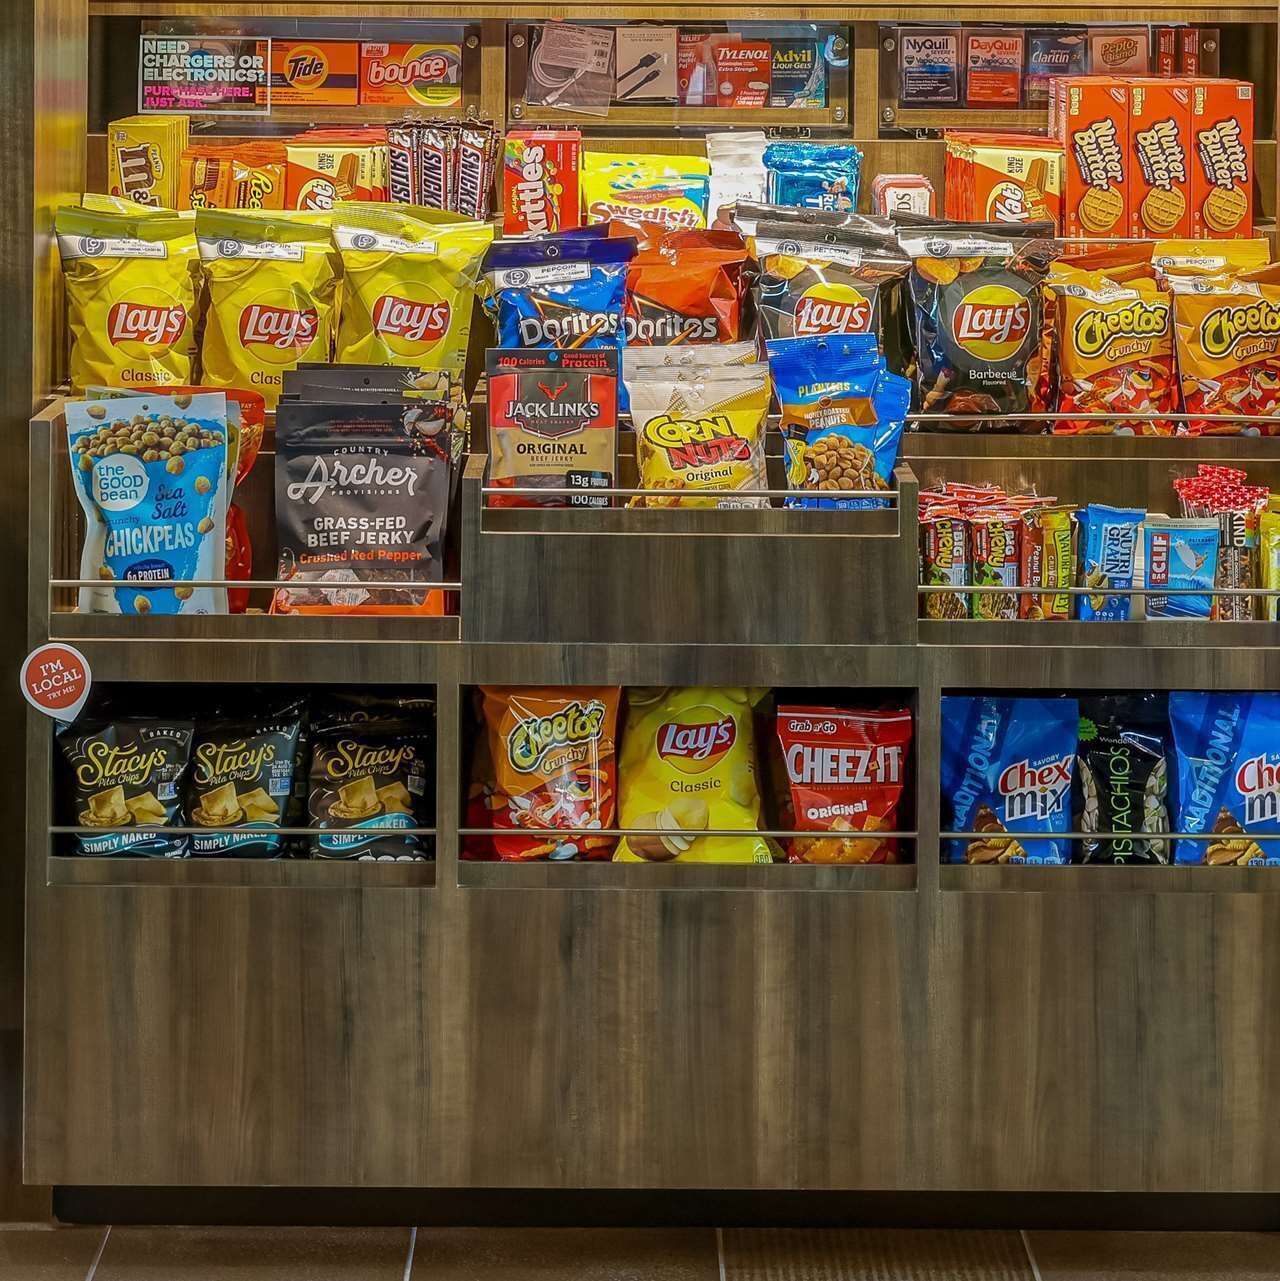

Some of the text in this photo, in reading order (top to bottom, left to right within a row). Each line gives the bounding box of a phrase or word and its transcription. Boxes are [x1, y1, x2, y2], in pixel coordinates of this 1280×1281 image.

[144, 41, 189, 53] NEED
[718, 48, 768, 59] TYLENOL
[906, 39, 949, 52] NyQuil
[971, 39, 1018, 53] DayQuil
[144, 55, 264, 68] CHARGERS OR
[773, 50, 811, 62] Advil
[1032, 50, 1069, 64] Claritin
[144, 68, 265, 82] ELECTRONICS?
[289, 56, 324, 82] Tide
[370, 58, 445, 84] bounce
[144, 86, 215, 96] PURCHASE
[144, 97, 208, 108] JUST ASK.
[1074, 129, 1110, 190] Butter
[1092, 118, 1124, 183] Nutter
[1136, 129, 1172, 190] Butter
[1154, 118, 1185, 183] Nutter
[1199, 129, 1234, 190] Butter
[1216, 118, 1248, 183] Nutter
[151, 148, 162, 173] PEANUT
[318, 153, 326, 169] KING
[327, 153, 335, 169] SIZE
[1007, 156, 1015, 174] KING
[1016, 155, 1024, 174] SIZE
[112, 303, 185, 347] Lay's
[375, 295, 450, 341] Lay's
[799, 299, 865, 333] Lay's
[959, 302, 1026, 344] Lay's
[243, 305, 319, 349] Lay's
[522, 312, 618, 346] Doritos
[625, 317, 717, 341] Doritos
[1074, 303, 1169, 358] Cheetos
[1107, 339, 1151, 361] Crunchy
[1234, 338, 1277, 359] Crunchy
[499, 357, 517, 367] 100
[562, 360, 608, 368] Protein
[121, 368, 171, 385] Classic
[969, 367, 1017, 380] Barbecue
[799, 382, 851, 397] PLANTERS
[505, 401, 599, 418] JACK LINK'S
[810, 414, 847, 428] PEANUTS
[644, 415, 733, 448] CORN
[334, 446, 389, 456] COUNTRY
[517, 443, 587, 454] ORIGINAL
[669, 437, 750, 470] NUTS
[97, 465, 124, 476] the
[686, 467, 732, 481] Original
[99, 476, 143, 490] GOOD
[287, 456, 417, 505] Archer
[571, 475, 589, 487] 13g
[100, 490, 138, 502] bean
[155, 484, 184, 500] Sea
[152, 504, 188, 520] Salt
[313, 516, 407, 531] GRASS-FED
[1233, 511, 1246, 547] KIND
[105, 522, 195, 557] CHICKPEAS
[307, 530, 414, 548] BEEF JERKY
[954, 532, 962, 556] BIG
[300, 549, 422, 565] Crushed Red Pepper
[1058, 533, 1070, 564] NATURE
[1106, 527, 1120, 575] GRAIN
[1120, 527, 1132, 574] NUTRI
[1152, 535, 1167, 573] CLIF
[1033, 545, 1042, 571] Peanut
[138, 568, 170, 580] PROTEIN
[39, 660, 64, 677] I'M
[32, 668, 82, 695] LOCAL
[47, 685, 76, 700] TRY ME!
[149, 730, 181, 738] BAKED
[788, 720, 837, 734] Grab Go
[509, 700, 607, 773] Cheetos
[661, 720, 732, 760] Lay's
[77, 741, 167, 786] Stacy's
[194, 741, 275, 784] Stacy's
[327, 740, 415, 778] Stacy's
[543, 747, 588, 772] Crunchy
[1033, 754, 1060, 767] SAVORY
[98, 773, 139, 787] Pita Chips
[209, 770, 250, 786] Pita Chips
[999, 755, 1075, 796] Chex
[670, 779, 721, 793] Classic
[1006, 785, 1070, 822] mix
[84, 837, 119, 852] SIMPLY
[194, 834, 231, 850] SIMPLY
